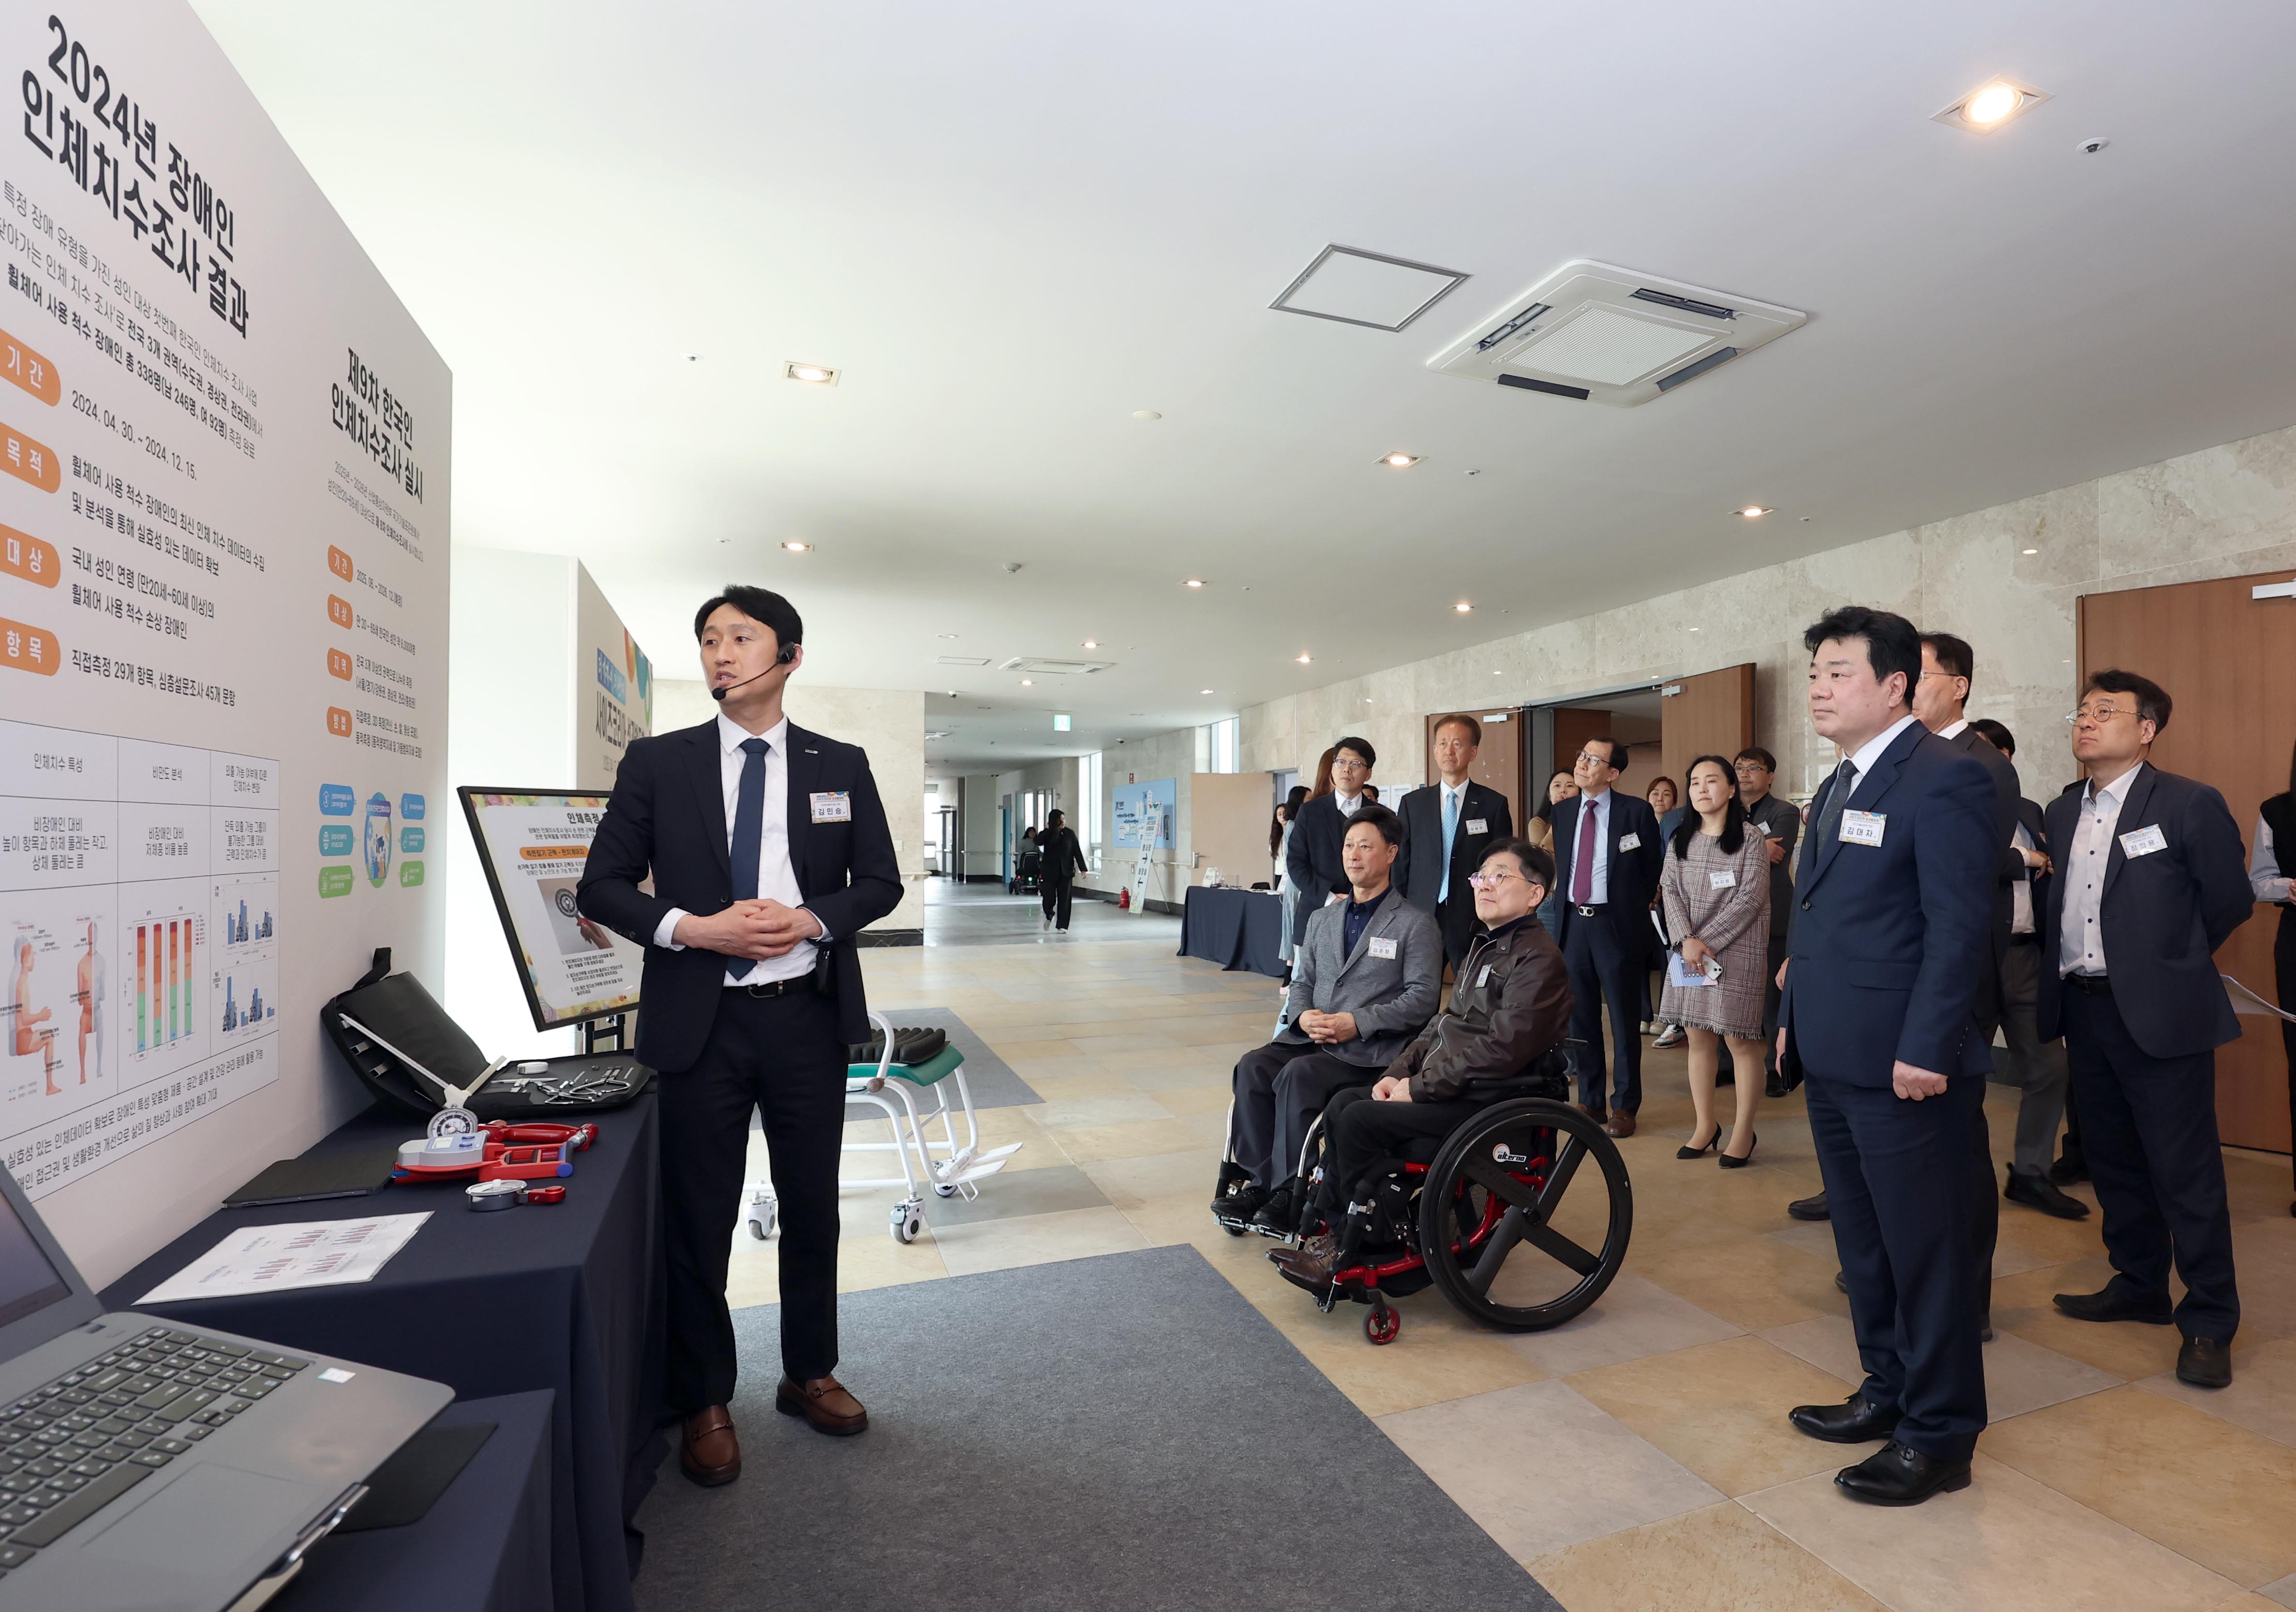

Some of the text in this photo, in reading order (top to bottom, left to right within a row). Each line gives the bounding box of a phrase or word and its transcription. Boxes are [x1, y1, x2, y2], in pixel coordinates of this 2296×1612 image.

[49, 15, 233, 263] 2024년 장애인
[22, 70, 248, 339] 인체치수조사 결과
[4, 181, 257, 407] 특정 장애 유형을 가진 성인 대상 첫번째 한국인 인체치수 조사 사업
[8, 263, 255, 459] 휠체어 사용 척수 장애인 총 338명(남 246명, 여 92명) 측정 완료
[47, 255, 66, 288] 인체
[71, 275, 91, 304] 치수
[128, 319, 144, 348] 전국
[147, 336, 160, 360] 3개
[163, 347, 205, 394] 권역(수도권,
[208, 381, 229, 413] 경상권,
[231, 401, 262, 436] 전라권)에서
[72, 390, 100, 422] 2024.
[104, 411, 118, 433] 04.
[122, 422, 135, 443] 30.
[146, 437, 168, 464] 2024.
[172, 453, 183, 472] 12.
[186, 462, 196, 480] 15.
[348, 347, 412, 451] 제9차 한국인
[332, 383, 401, 483] 인체치수조사
[405, 457, 422, 504] 실시
[72, 455, 264, 572] 휠체어 사용 척수 장애인의 최신 인체 치수 데이터의 수집
[73, 492, 218, 576] 및 분석을 통해 실효성 있는 데이터 확보
[72, 547, 91, 573] 국내
[96, 557, 113, 581] 성인
[117, 565, 134, 588] 연령
[191, 595, 214, 619] 이상)의
[72, 584, 186, 640] 휠체어 사용 척수 손상 장애인
[72, 650, 235, 706] 직접측정 29개 항목, 심층설문조사 45개 문항
[34, 753, 82, 773] 인체치수 특성
[153, 766, 182, 780] 비만도 분석
[3, 836, 108, 851] 높이 항목과 하체 둘레는 작고,
[34, 817, 82, 832] 비장애인 대비
[567, 812, 600, 824] 인체측정
[33, 855, 48, 871] 상체
[52, 855, 73, 869] 둘레는
[1497, 1151, 1525, 1161] alterna
